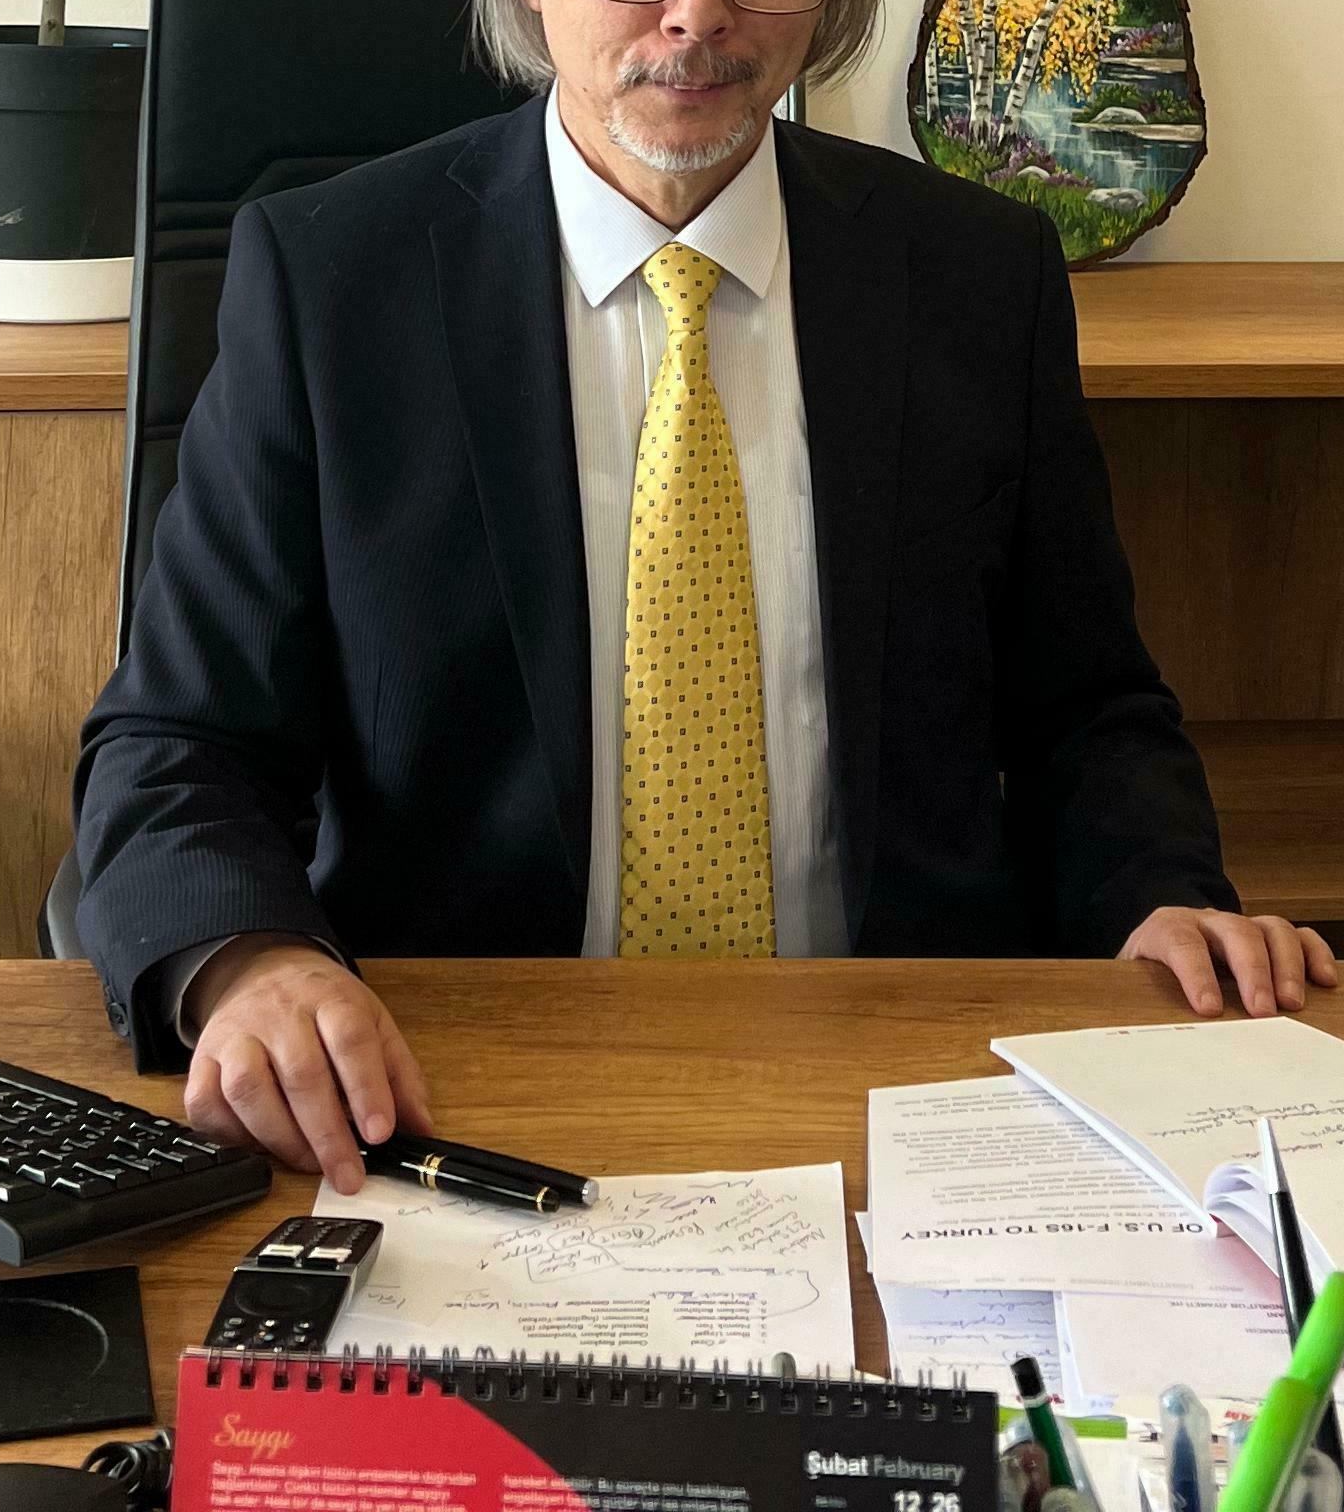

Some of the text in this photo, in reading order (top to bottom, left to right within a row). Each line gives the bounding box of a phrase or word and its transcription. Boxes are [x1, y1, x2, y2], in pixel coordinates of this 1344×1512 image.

[900, 1221, 1203, 1240] OF U.S. F-16S TO TURKEY
[211, 1413, 295, 1460] Saygı
[805, 1450, 966, 1487] Şubat February
[893, 1490, 961, 1512] 12 26
